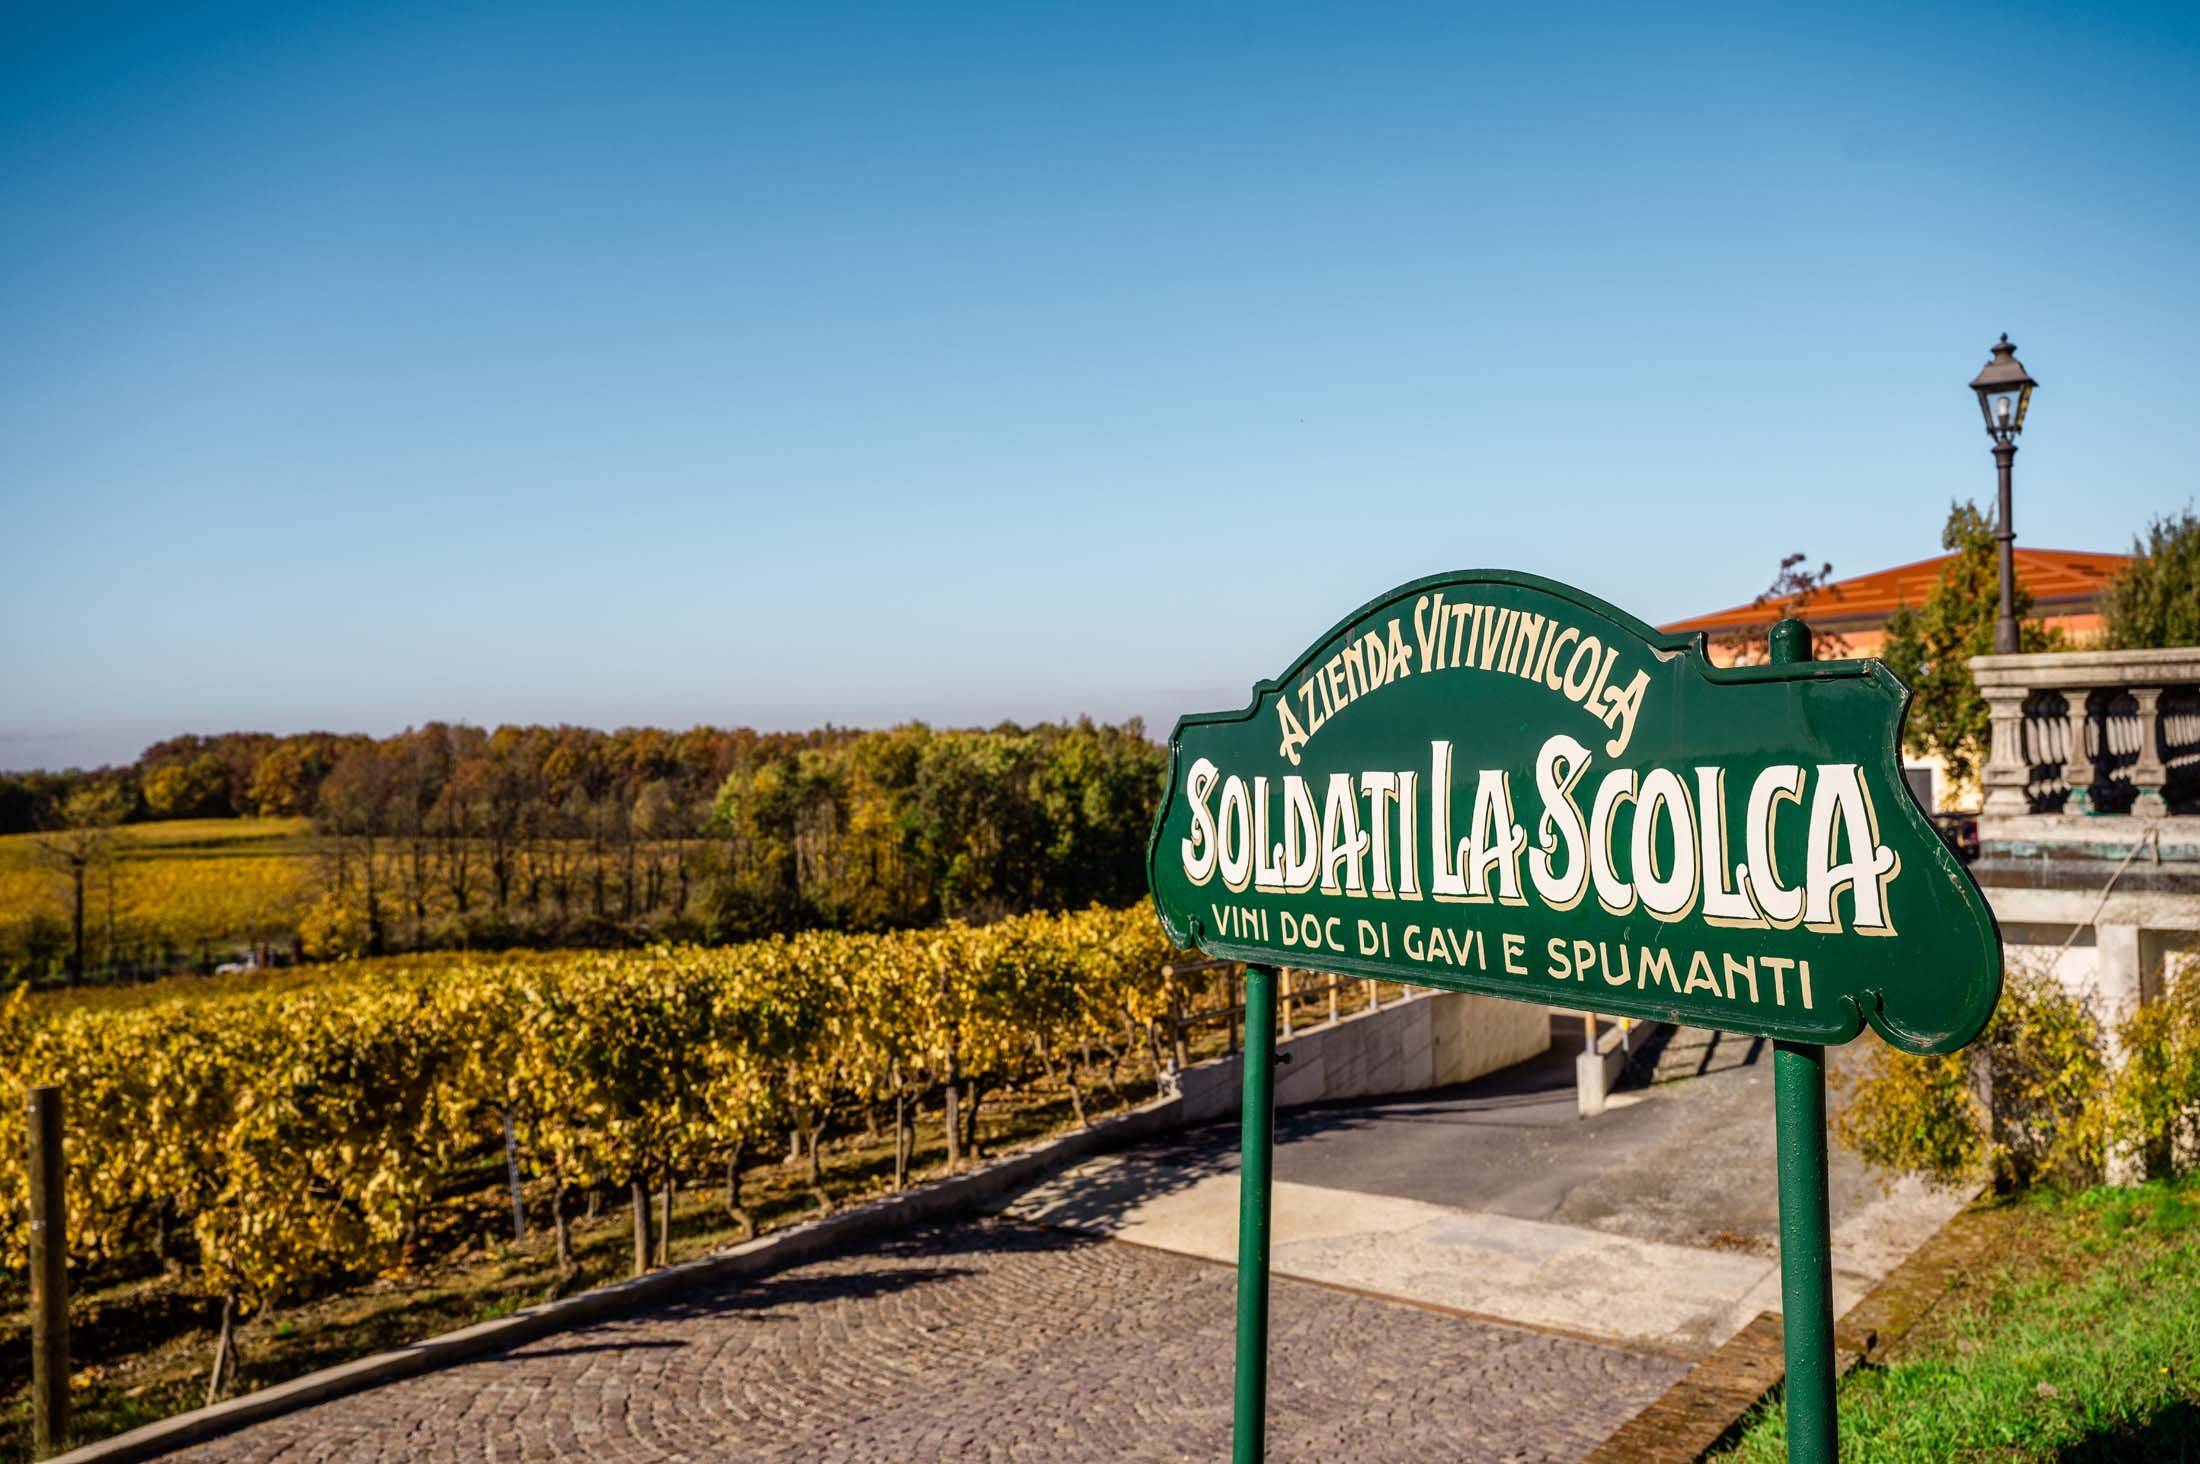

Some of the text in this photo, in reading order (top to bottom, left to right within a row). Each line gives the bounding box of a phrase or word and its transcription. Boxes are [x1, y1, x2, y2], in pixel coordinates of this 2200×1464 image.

[1275, 592, 1651, 766] AZIENDA VITIVINICOLA
[1181, 733, 1902, 938] SOLDATI LA SCOLCA
[1210, 902, 1814, 1010] VINI DOC DI GAVI E SPUMANTI
